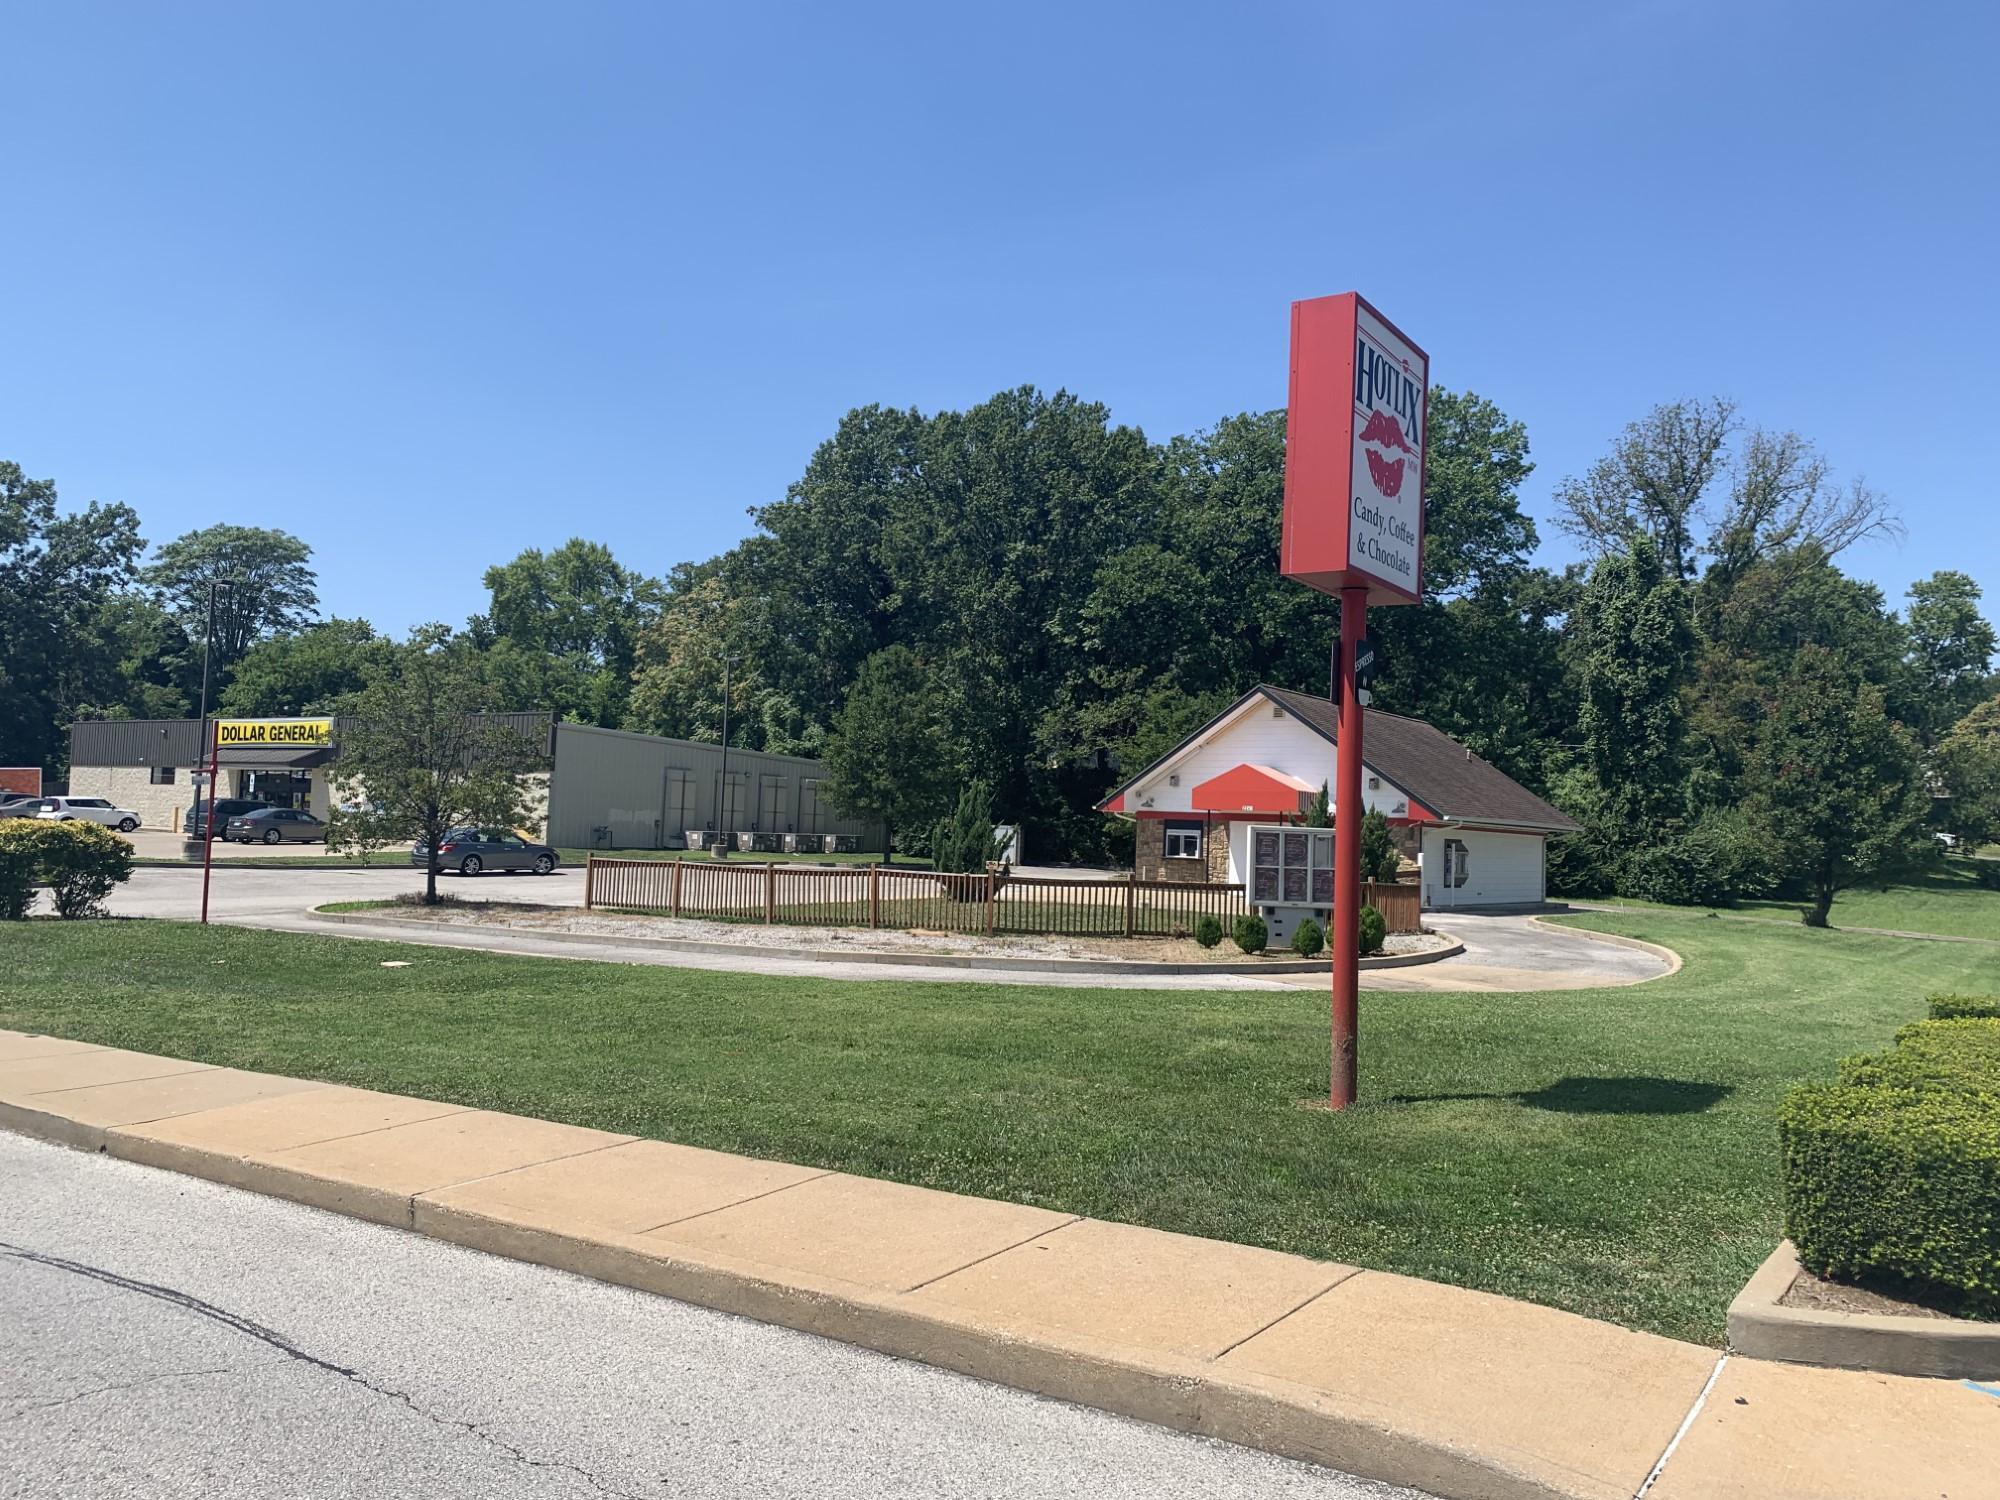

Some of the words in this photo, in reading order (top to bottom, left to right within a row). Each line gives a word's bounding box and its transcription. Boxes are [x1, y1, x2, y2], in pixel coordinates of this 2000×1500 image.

[1356, 338, 1421, 446] HOTLIX
[1354, 497, 1387, 536] Candy,
[1388, 516, 1415, 547] Coffee
[1357, 532, 1366, 555] &
[1368, 538, 1410, 576] Chocolate
[221, 726, 265, 741] DOLLAR
